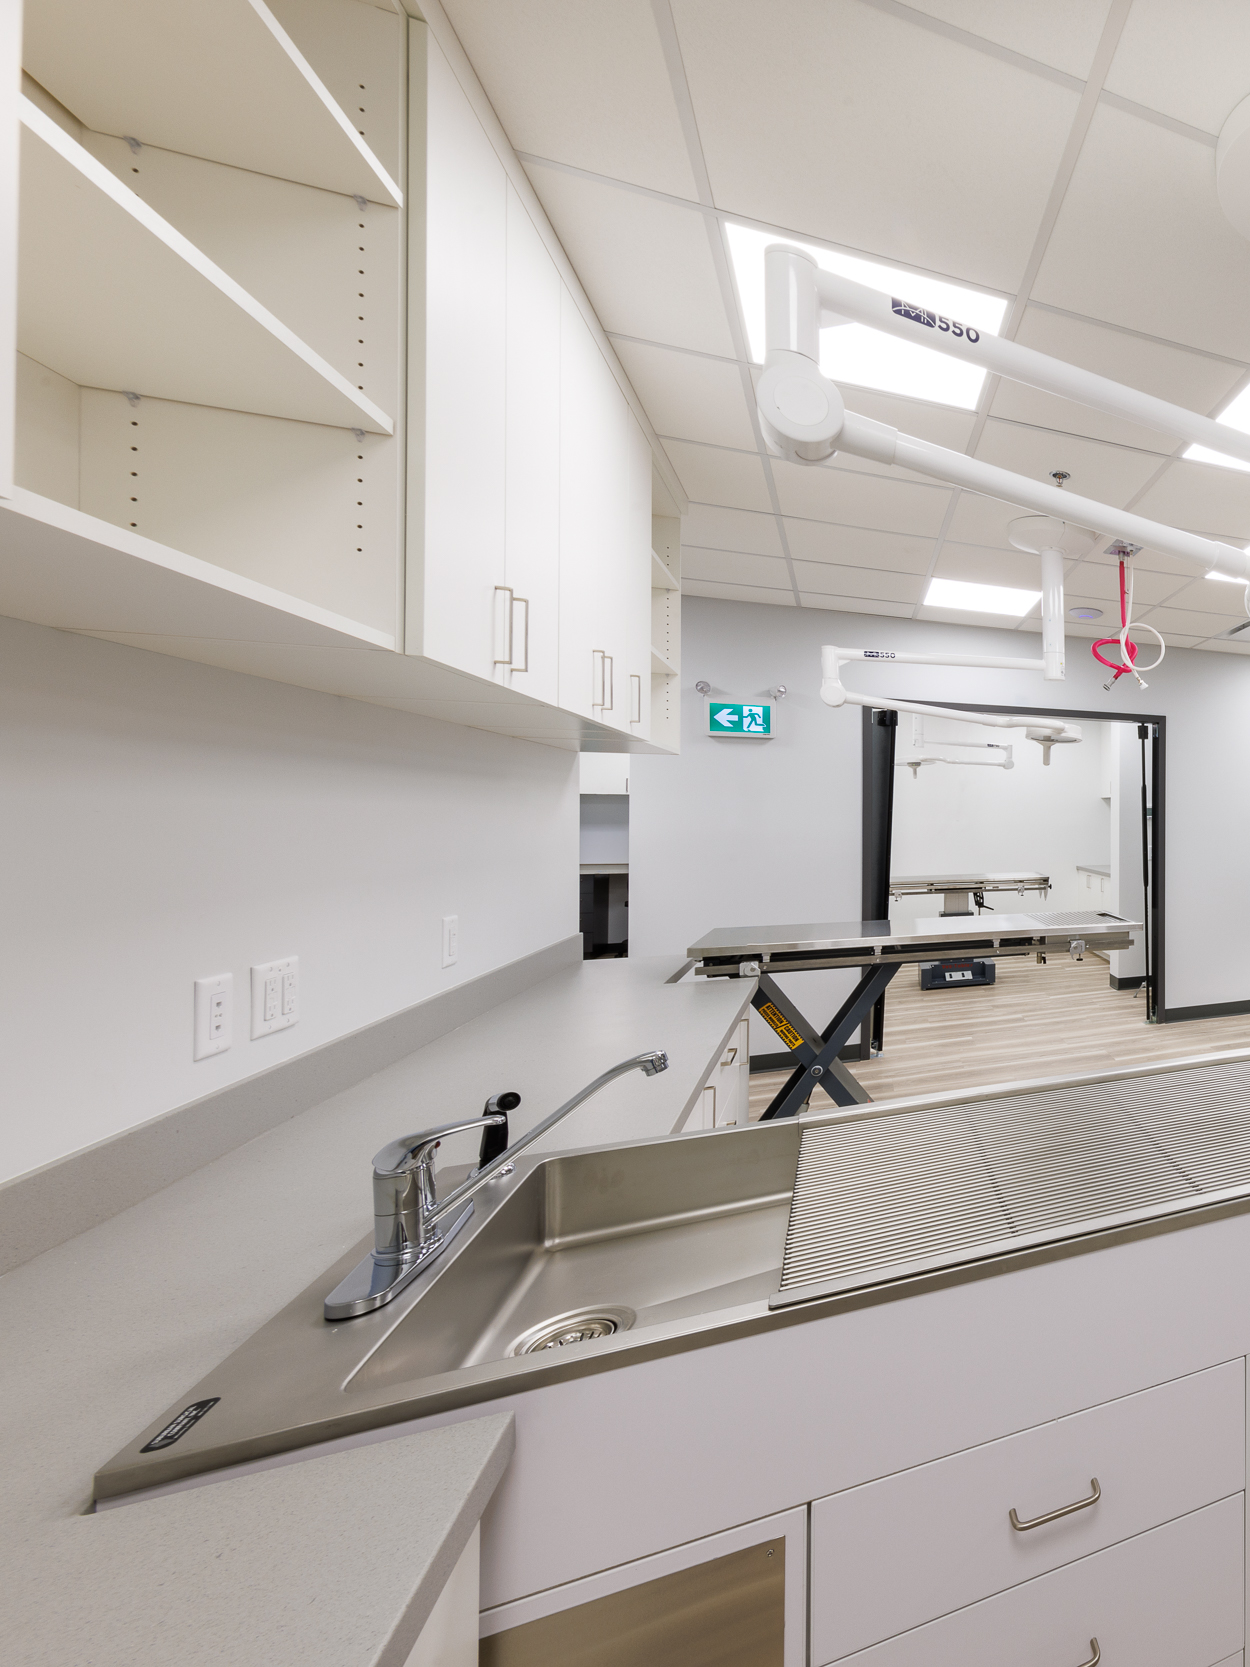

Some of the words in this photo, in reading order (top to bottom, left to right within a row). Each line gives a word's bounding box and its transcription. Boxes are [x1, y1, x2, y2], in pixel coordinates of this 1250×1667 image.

[937, 315, 980, 344] 550
[764, 1004, 785, 1025] ATTENTION
[783, 1025, 800, 1043] CAUTION
